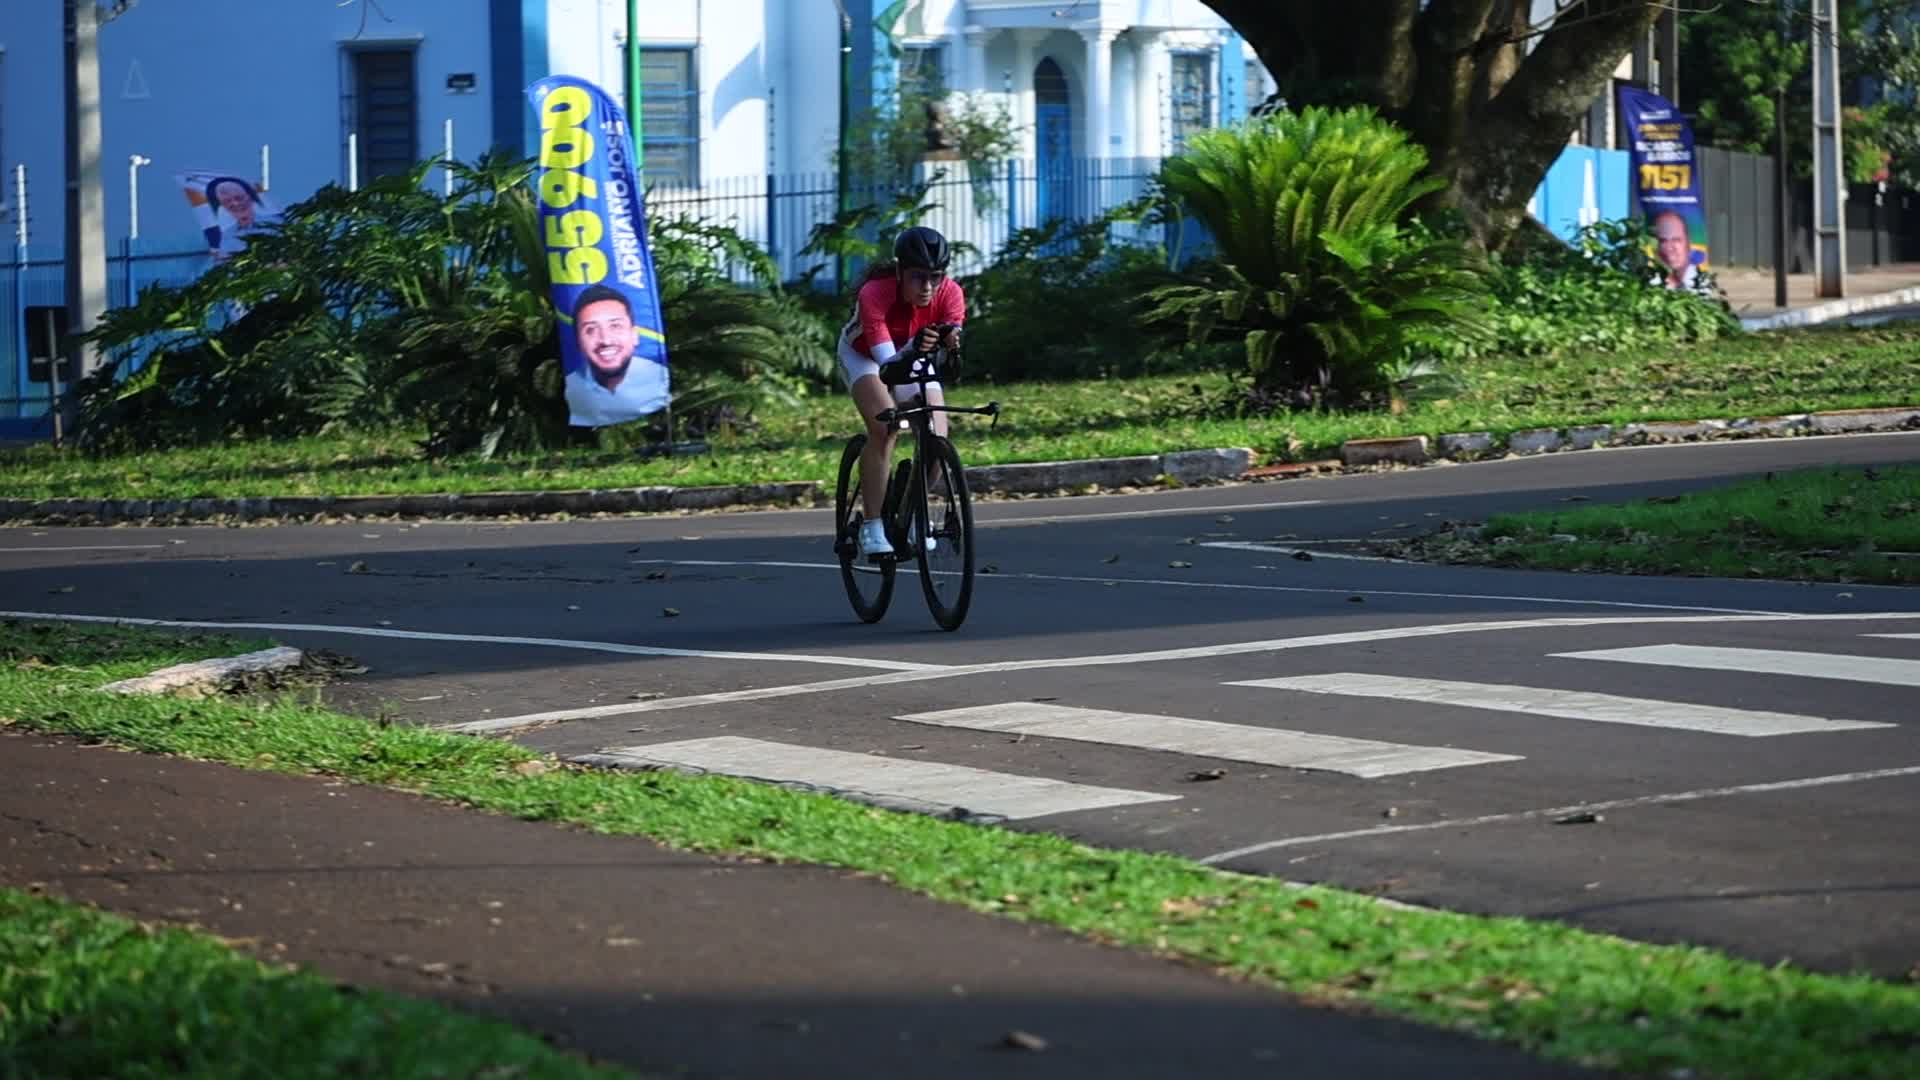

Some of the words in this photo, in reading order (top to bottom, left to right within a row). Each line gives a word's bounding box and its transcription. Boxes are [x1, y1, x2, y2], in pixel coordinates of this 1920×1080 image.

[539, 86, 608, 284] 55900
[601, 120, 625, 180] JOSÉ
[612, 181, 645, 288] ADRIANO
